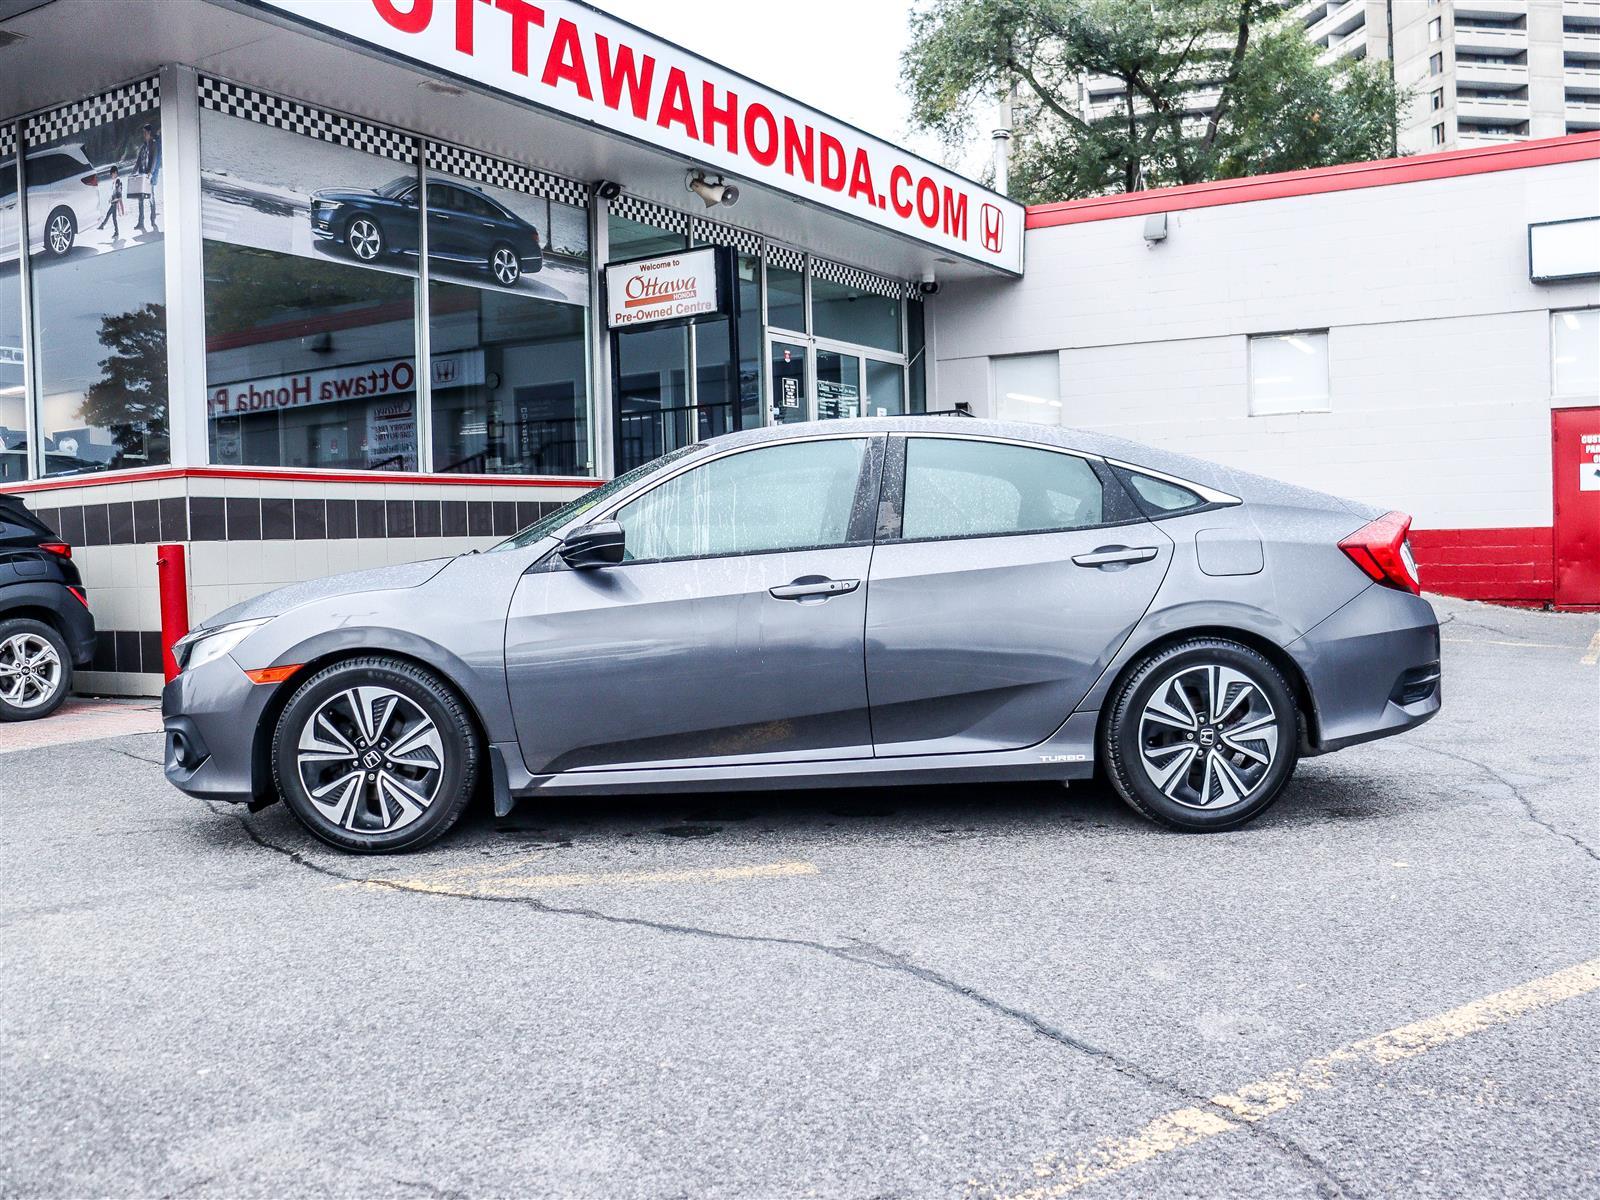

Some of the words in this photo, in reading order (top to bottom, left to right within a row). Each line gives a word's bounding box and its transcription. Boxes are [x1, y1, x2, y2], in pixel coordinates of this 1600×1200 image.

[640, 260, 671, 272] Welcome
[672, 259, 680, 267] to
[625, 275, 697, 299] Ottawa
[673, 290, 696, 300] HONDA
[615, 305, 673, 323] Pre-Owned
[676, 301, 712, 314] Centre
[1039, 754, 1086, 762] TURBO
